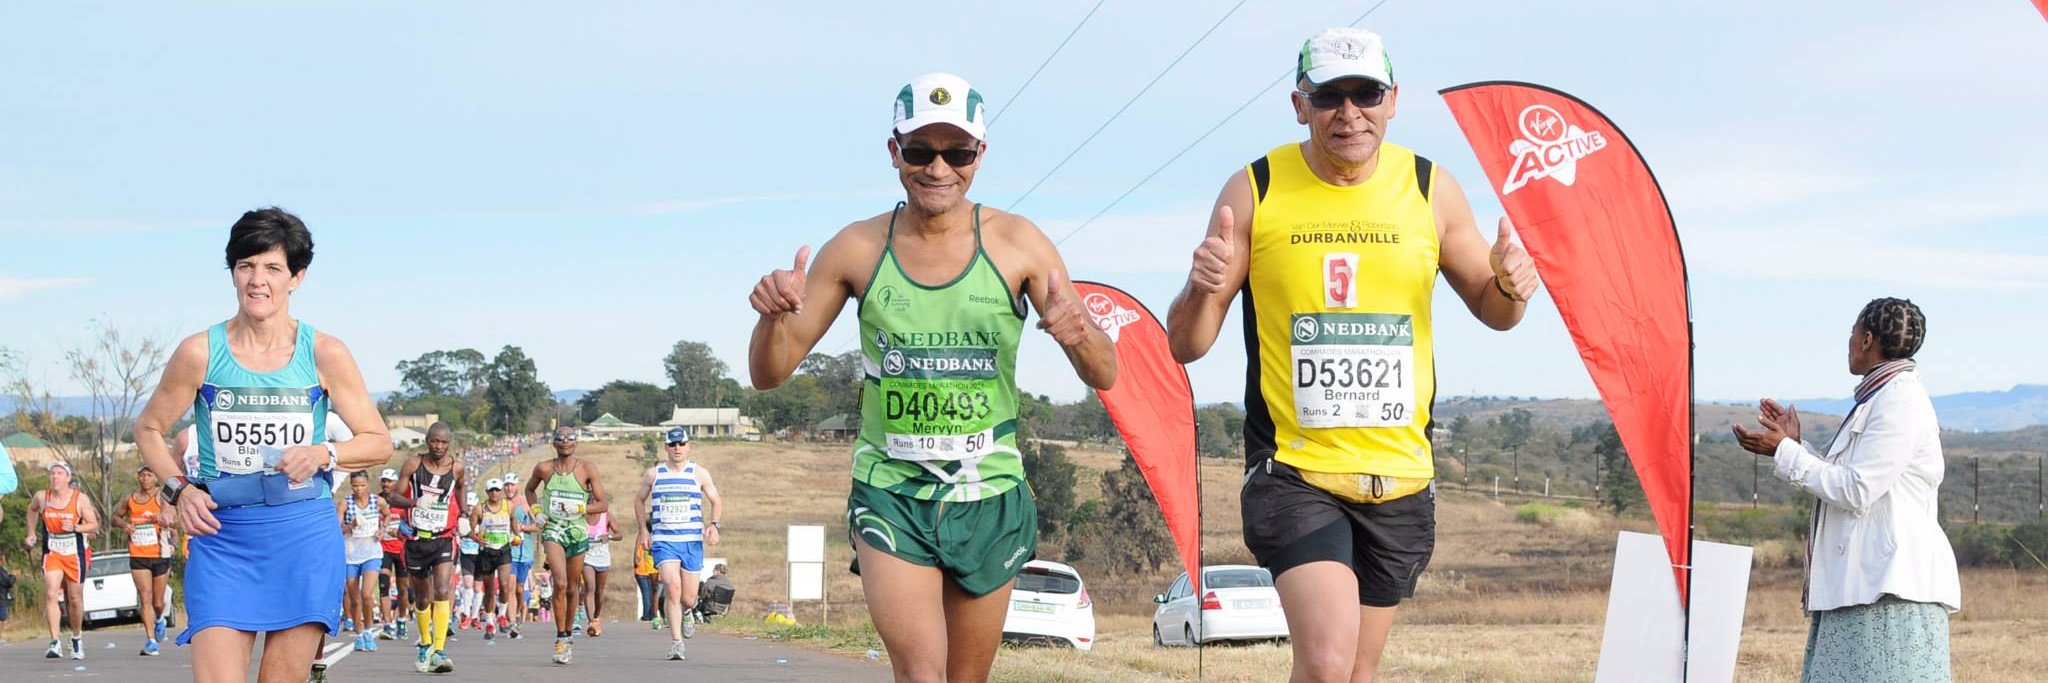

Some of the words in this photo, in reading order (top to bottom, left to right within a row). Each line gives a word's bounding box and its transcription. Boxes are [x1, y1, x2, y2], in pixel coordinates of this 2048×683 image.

[1512, 133, 1603, 184] ACTIVE
[1350, 220, 1361, 233] &
[1290, 232, 1400, 245] DURBANVILLE
[1329, 258, 1350, 302] 5
[969, 294, 1000, 304] Reebok
[1092, 311, 1138, 330] CTIVE
[1323, 322, 1410, 336] NEDBANK
[891, 331, 1001, 346] NEDBANK
[908, 357, 994, 371] NEDBANK
[1297, 358, 1402, 389] D53621
[237, 395, 310, 406] NEDBANK
[1324, 389, 1380, 401] Bernard
[886, 390, 992, 421] D40493
[1302, 406, 1328, 417] Runs
[1332, 404, 1341, 417] 2
[1380, 402, 1404, 421] 50
[217, 421, 305, 445] D55510
[912, 422, 963, 436] Mervyn
[893, 437, 914, 449] Runs
[919, 437, 935, 449] 10
[965, 432, 985, 453] 50
[221, 456, 241, 466] Runs
[244, 456, 252, 467] 6
